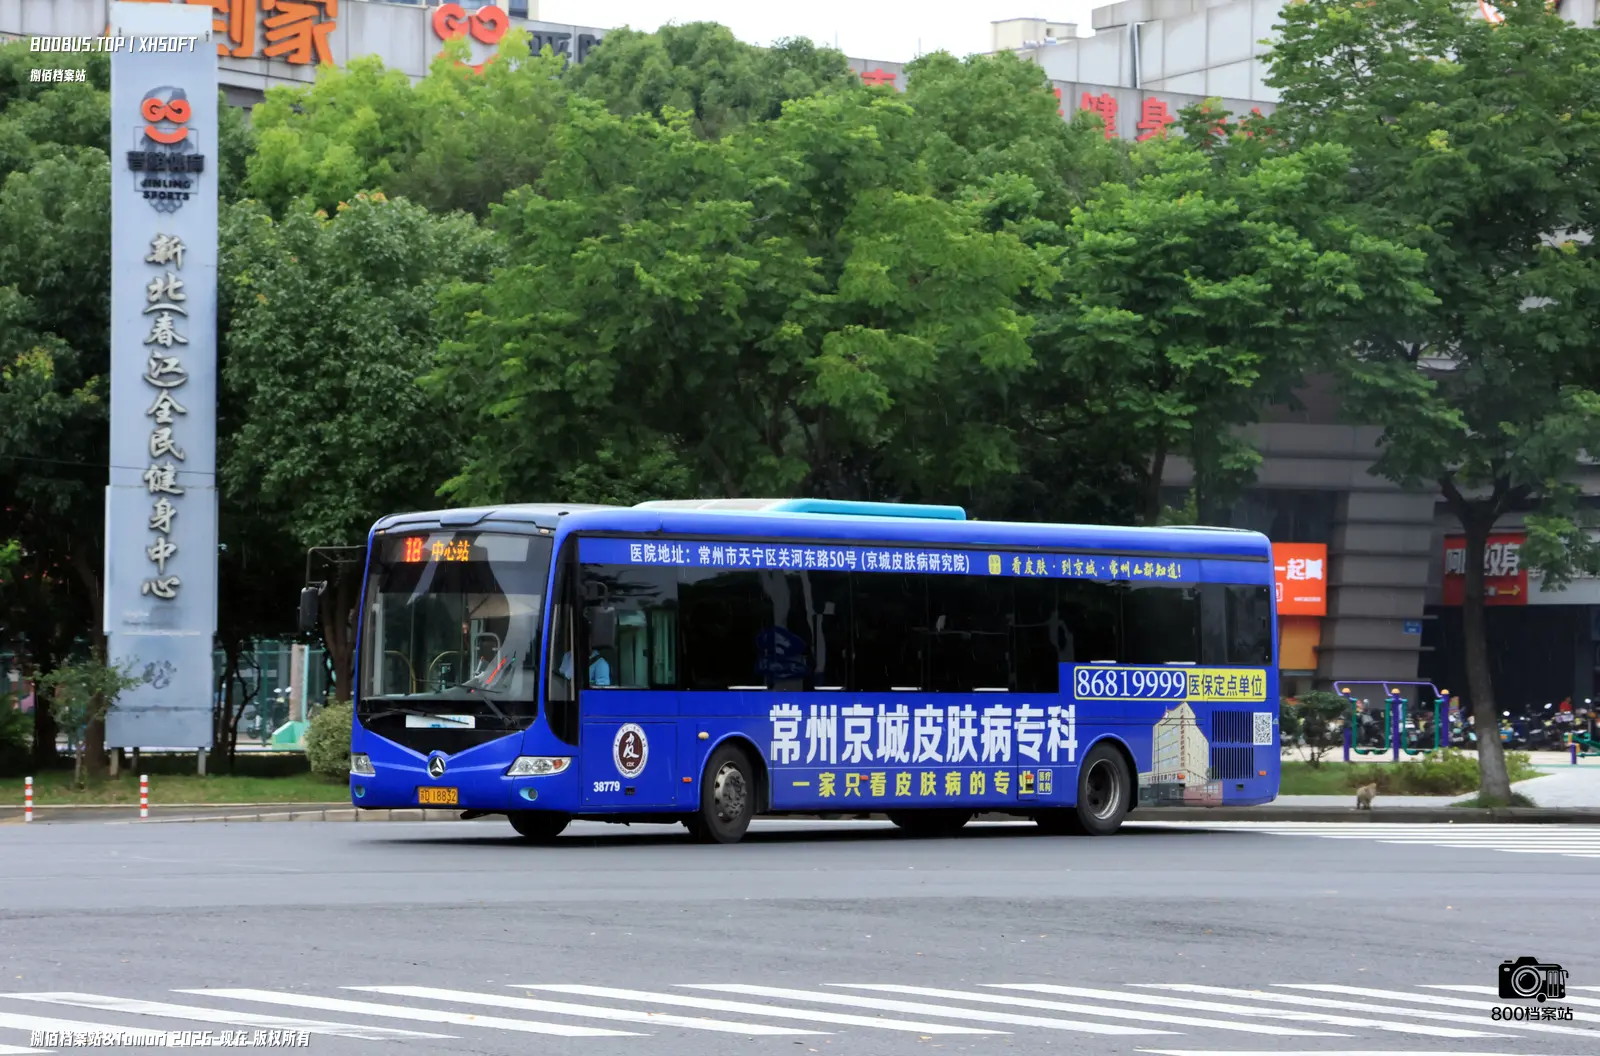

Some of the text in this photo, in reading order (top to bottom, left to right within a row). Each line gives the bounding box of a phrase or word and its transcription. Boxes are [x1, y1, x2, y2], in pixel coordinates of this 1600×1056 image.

[142, 191, 190, 201] SPORTS
[406, 537, 423, 562] 18
[431, 540, 470, 561] 中心站
[1076, 669, 1186, 698] 86819999
[1188, 674, 1263, 697] 医保定点单位
[769, 703, 1078, 764] 常州京城皮肤病专科
[593, 781, 620, 792] 38779
